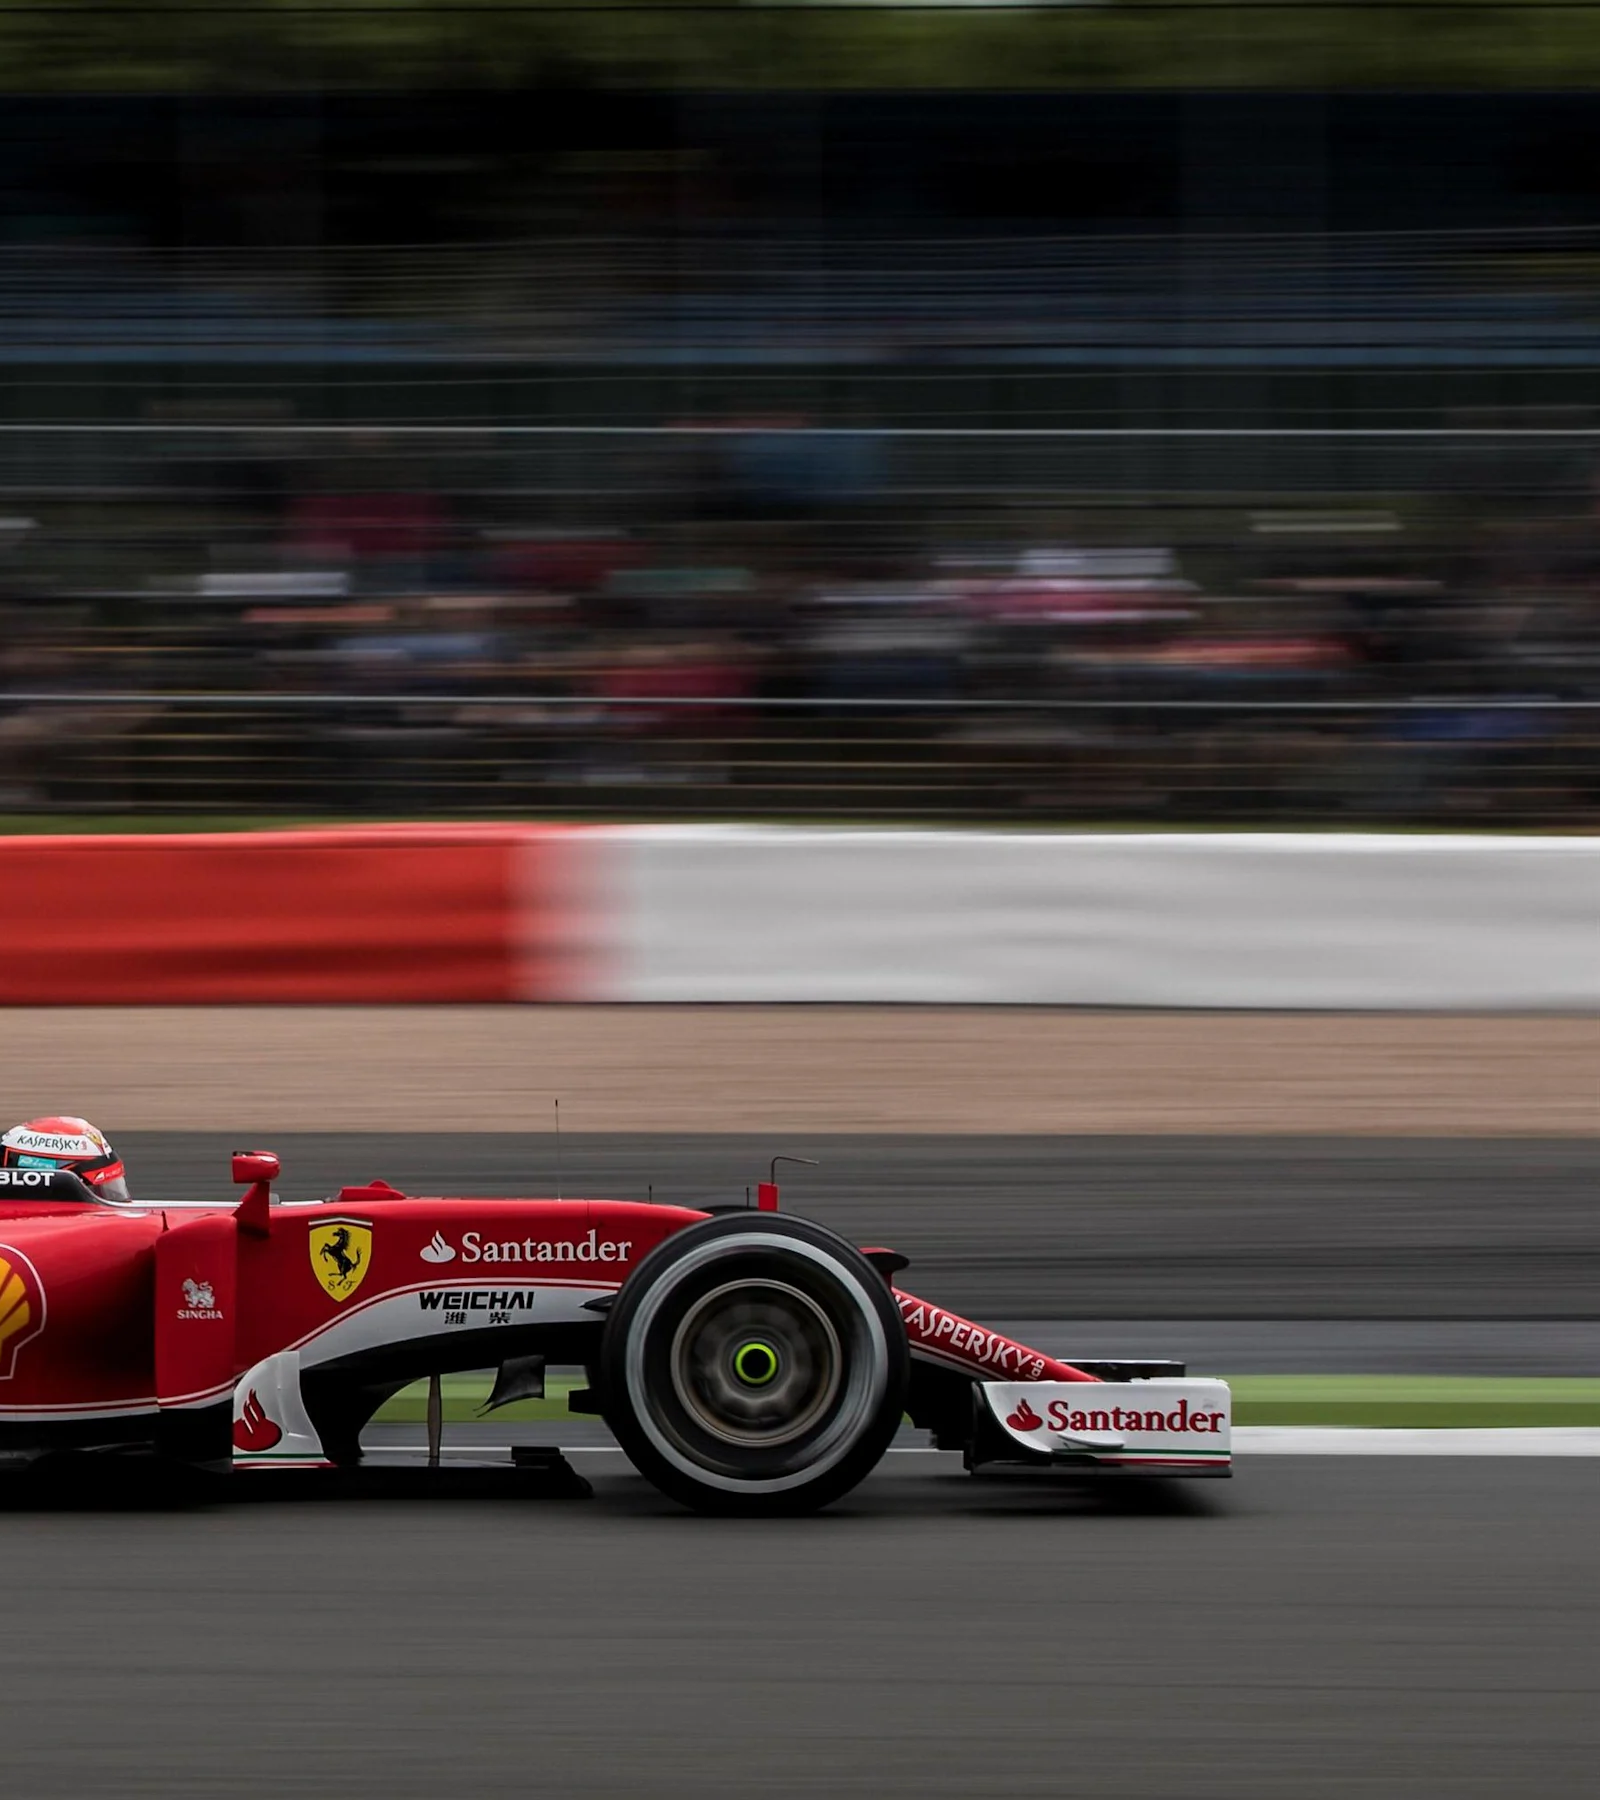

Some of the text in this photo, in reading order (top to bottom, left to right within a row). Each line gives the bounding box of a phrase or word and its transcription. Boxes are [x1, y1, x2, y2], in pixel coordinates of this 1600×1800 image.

[17, 1134, 80, 1151] KASPERSKY
[461, 1229, 632, 1263] Santander
[419, 1291, 535, 1310] WEICHAI
[176, 1309, 224, 1320] SINGHA
[895, 1295, 1045, 1380] KASPERSKY lab
[1048, 1399, 1226, 1433] Santander
